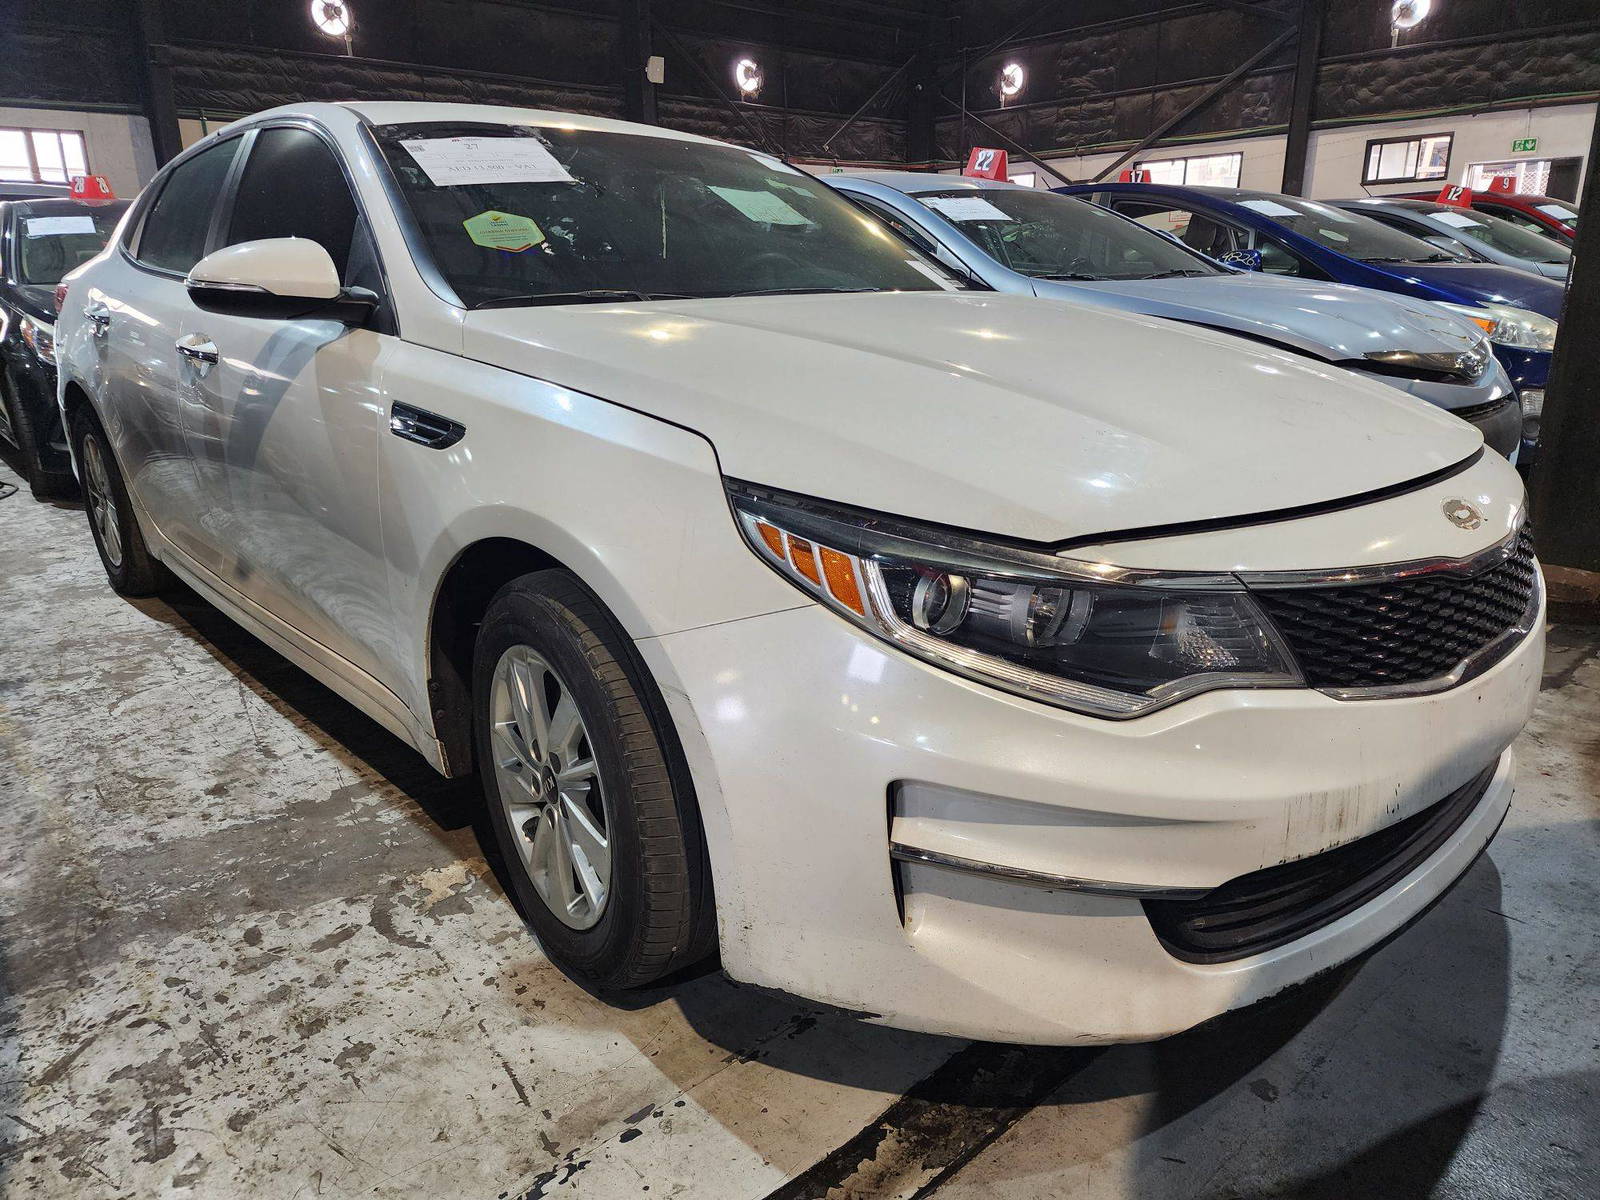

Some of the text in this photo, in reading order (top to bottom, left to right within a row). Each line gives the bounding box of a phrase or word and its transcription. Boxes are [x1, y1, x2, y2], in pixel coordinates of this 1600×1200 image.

[974, 150, 994, 171] 22
[1131, 170, 1142, 183] 17
[1503, 177, 1510, 190] 9
[75, 177, 84, 193] 28
[1447, 186, 1463, 200] 12
